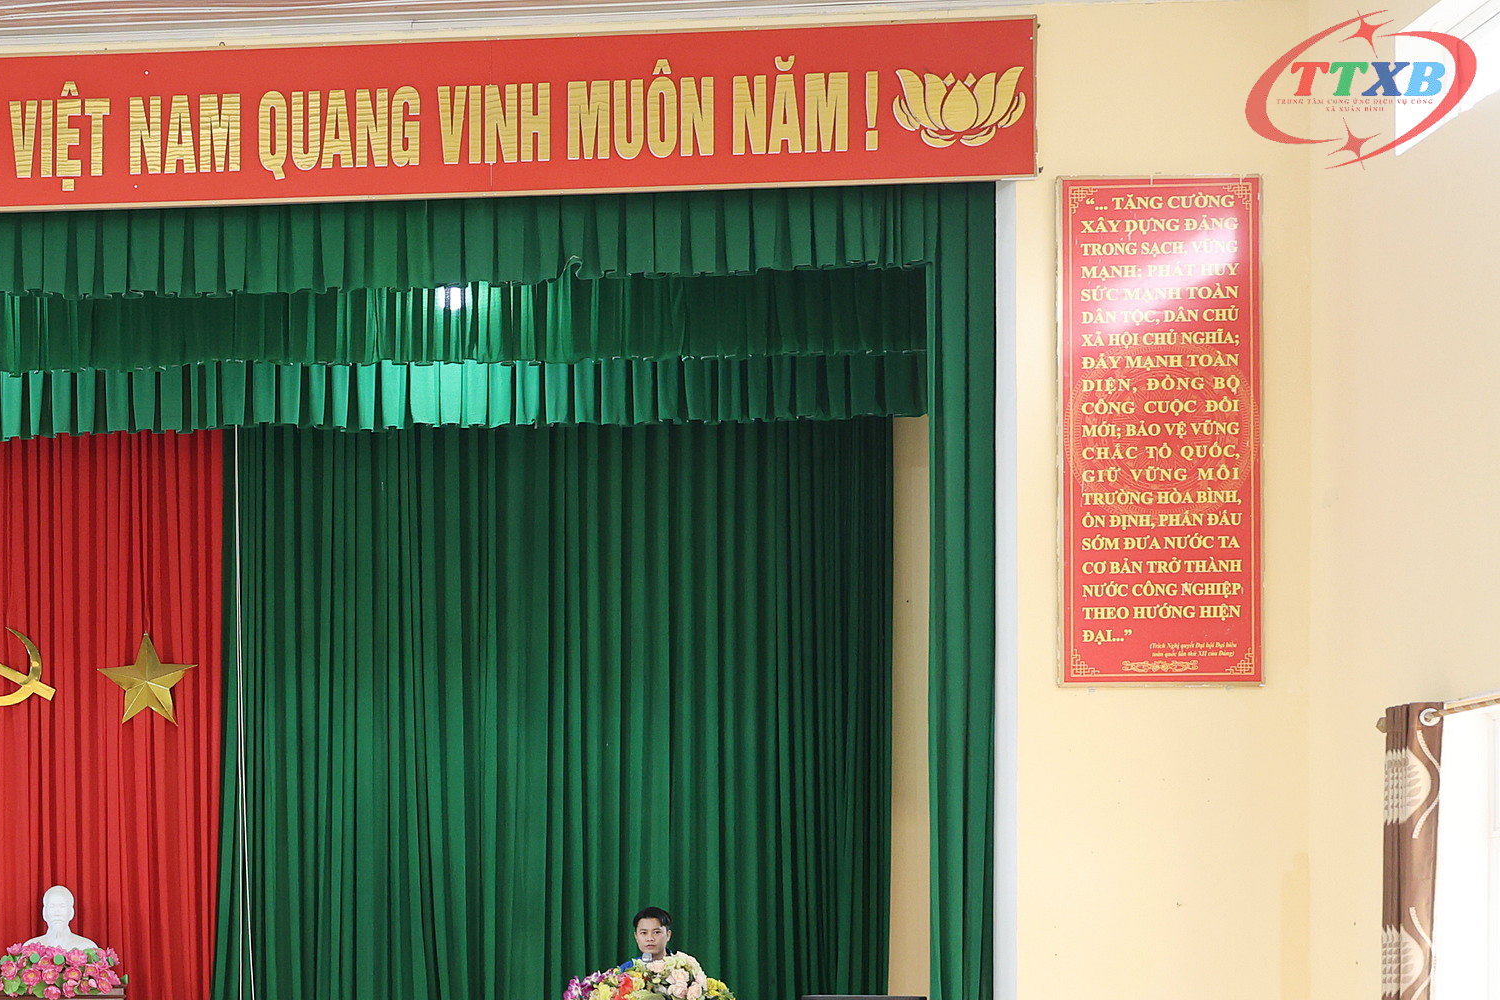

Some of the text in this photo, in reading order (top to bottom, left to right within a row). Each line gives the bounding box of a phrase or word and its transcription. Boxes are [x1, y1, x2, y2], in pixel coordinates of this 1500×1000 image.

[8, 81, 112, 192] VIỆT
[128, 92, 242, 176] NAM
[257, 86, 421, 180] QUANG
[438, 81, 551, 166] VINH
[567, 58, 715, 161] MUÔN
[733, 54, 849, 157] NĂM
[1112, 195, 1163, 209] TĂNG
[1167, 192, 1235, 208] CƯỜNG
[1081, 214, 1238, 233] XÂY DỰNG ĐẢNG
[1081, 237, 1238, 257] TRONG SẠCH, VỮNG
[1081, 262, 1239, 280] MẠNH; PHÁT HUY
[1081, 283, 1238, 303] SỨC MẠNH TOÀN
[1082, 305, 1239, 325] DÂN TỘC, DÂN CHỦ
[1081, 328, 1240, 349] XÃ HỘI CHỦ NGHĨA;
[1125, 355, 1183, 370] MẠNH
[1188, 351, 1239, 367] TOÀN
[1082, 374, 1240, 394] DIỆN, ĐỒNG BỘ
[1082, 395, 1239, 416] CÔNG CUỘC ĐỔI
[1082, 417, 1239, 439] MỚI; BẢO VỆ VỮNG
[1082, 441, 1240, 460] CHẮC TỔ QUỐC,
[1082, 463, 1239, 483] GIỮ VỮNG MÔI
[1083, 486, 1241, 505] TRƯỜNG HÒA BÌNH,
[1082, 510, 1242, 530] ỔN ĐỊNH, PHẤN ĐẤU
[1082, 534, 1240, 550] SỚM ĐƯA NƯỚC TA
[1082, 557, 1242, 574] CƠ BẢN TRỞ THÀNH
[1083, 580, 1241, 598] NƯỚC CÔNG NGHIỆP
[1083, 604, 1241, 620] THEO HƯỚNG HIỆN
